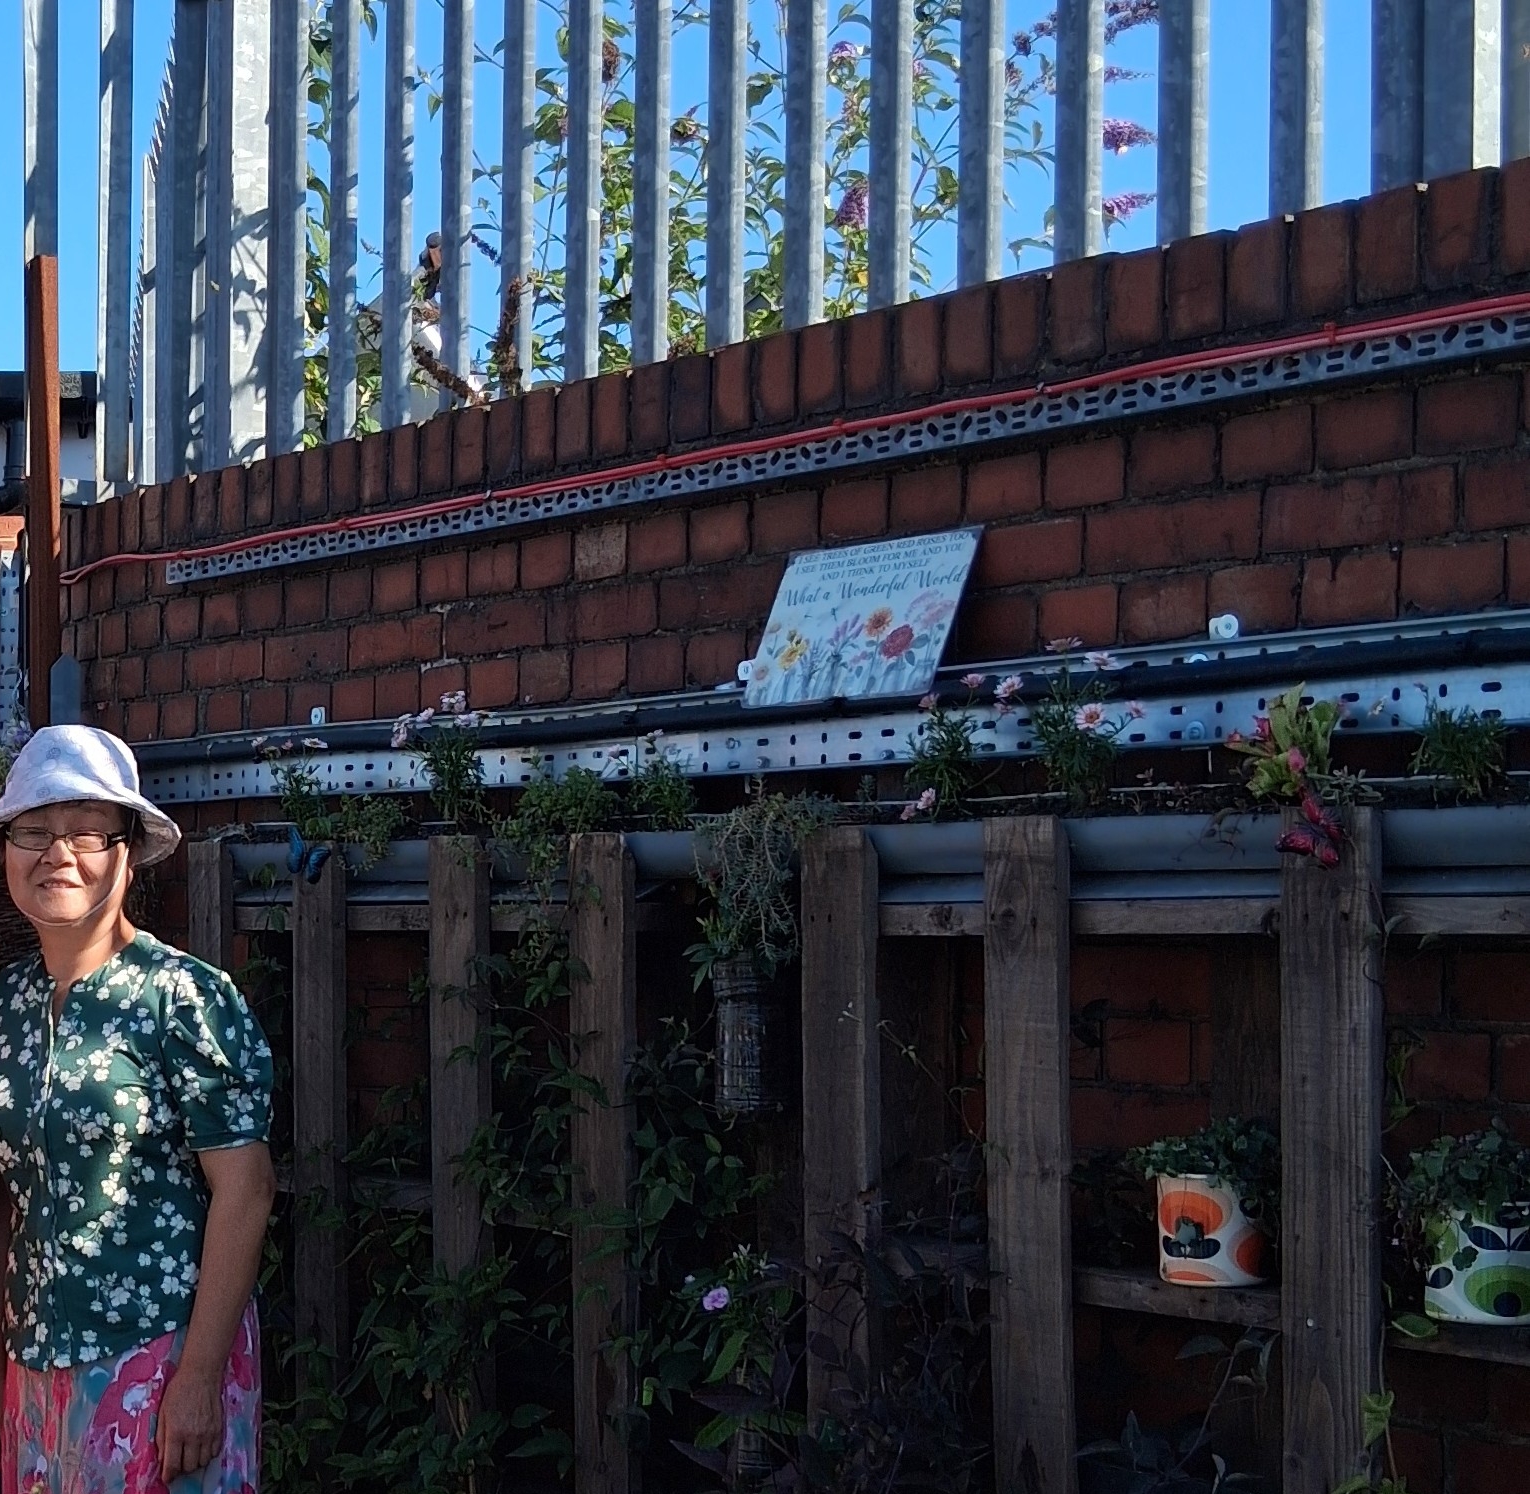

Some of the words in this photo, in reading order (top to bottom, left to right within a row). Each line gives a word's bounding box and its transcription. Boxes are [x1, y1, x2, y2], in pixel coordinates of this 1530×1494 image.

[850, 548, 861, 556] OF
[863, 543, 895, 554] GREEN
[896, 540, 915, 549] RED
[916, 534, 948, 546] ROSES
[949, 532, 969, 540] TOO
[800, 564, 816, 574] SEE
[819, 561, 845, 571] THEM
[846, 554, 881, 567] BLOOM
[882, 552, 901, 562] FOR
[903, 549, 918, 559] ME
[920, 546, 942, 556] AND
[944, 543, 962, 553] YOU
[821, 571, 840, 581] AND
[847, 567, 874, 578] THINK
[878, 564, 890, 573] TO
[891, 557, 931, 570] MYSELF
[785, 585, 821, 606] What
[822, 591, 830, 600] a
[838, 571, 911, 599] Wonderful
[914, 563, 968, 588] World
